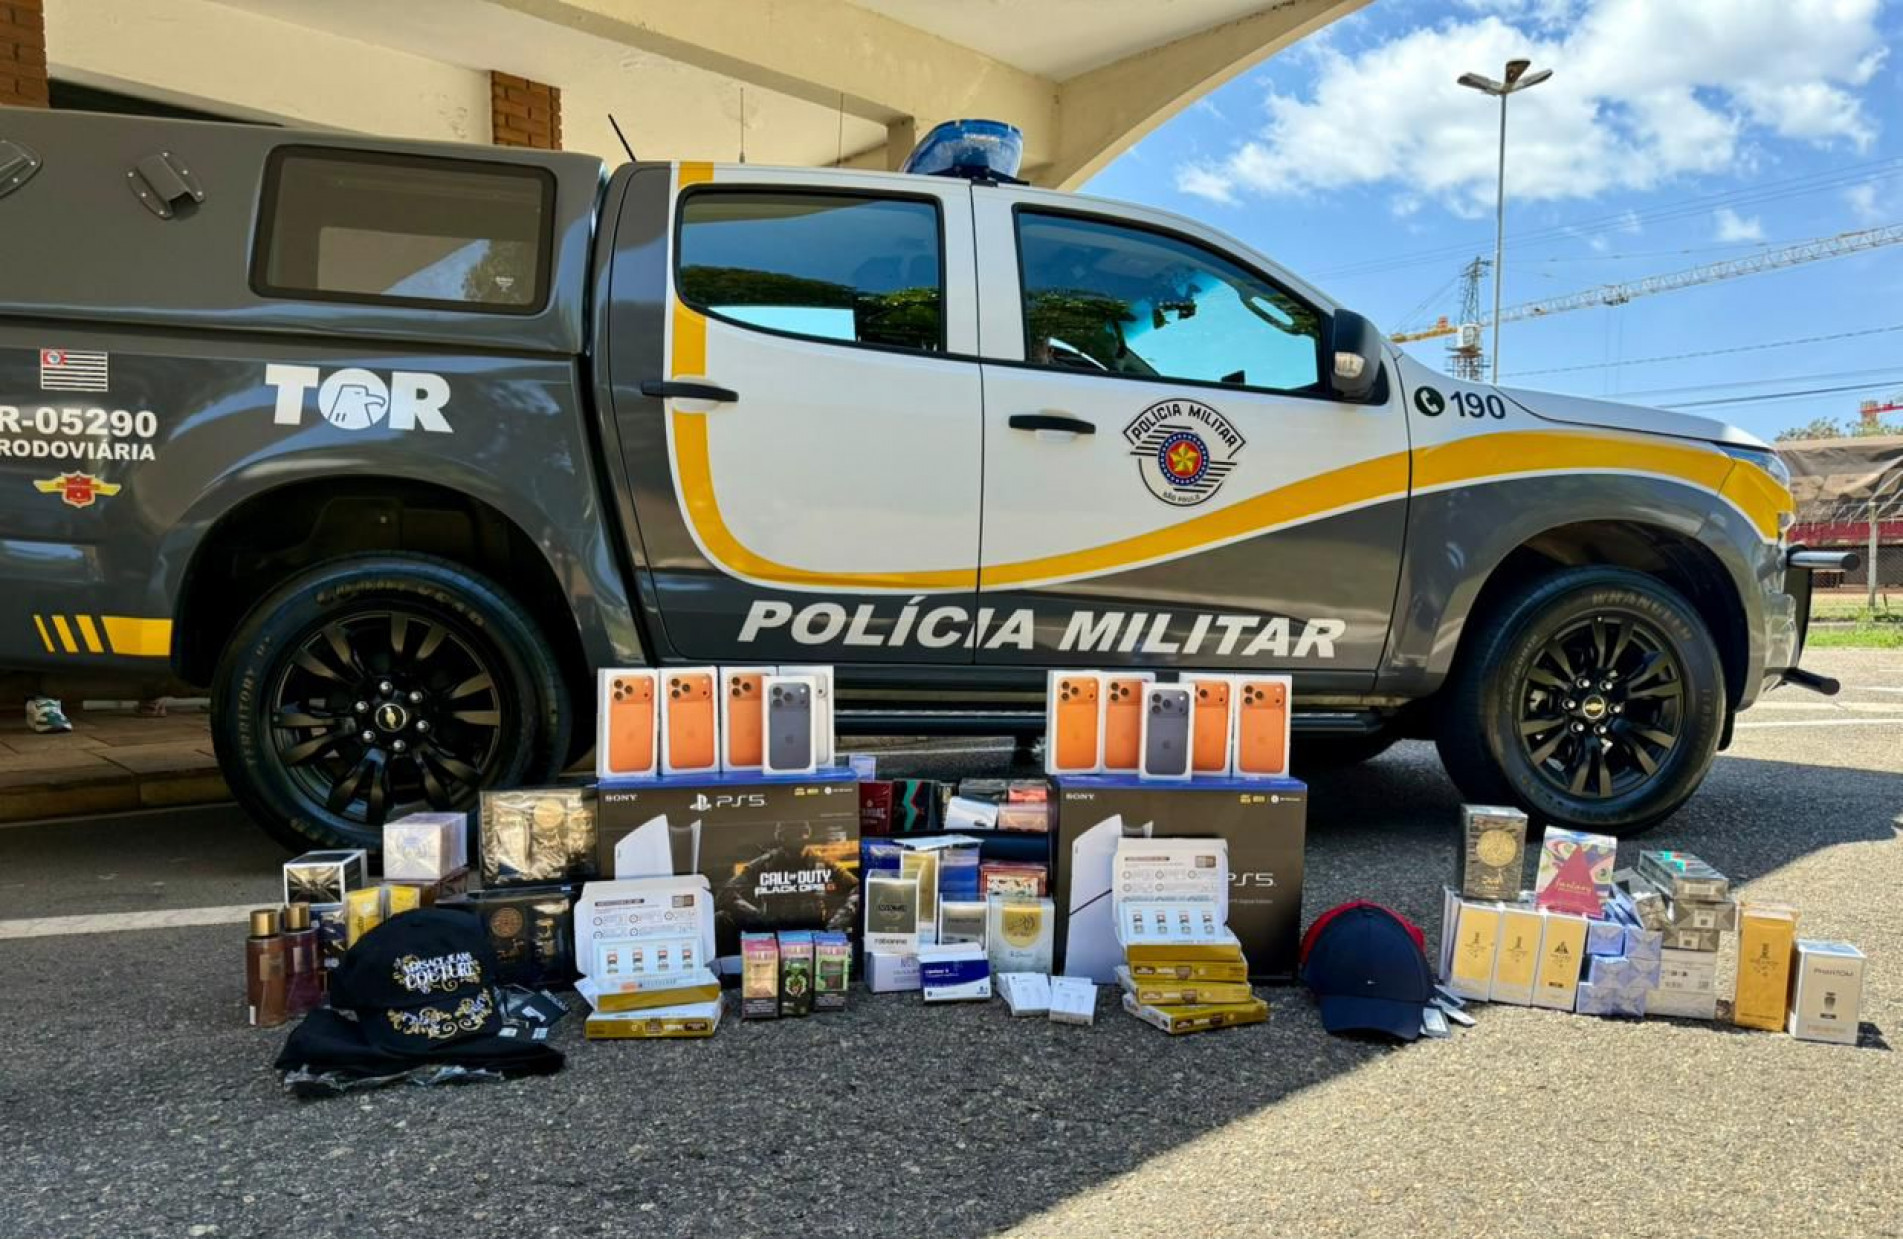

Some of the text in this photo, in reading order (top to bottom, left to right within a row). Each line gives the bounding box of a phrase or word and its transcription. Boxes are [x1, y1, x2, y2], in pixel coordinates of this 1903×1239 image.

[265, 363, 453, 433] TOR
[1450, 390, 1506, 420] 190
[0, 405, 157, 438] R-05290
[1187, 404, 1238, 448] MILITAR
[0, 438, 156, 460] RODOVIÁRIA
[737, 596, 1347, 659] POLÍCIA MILITAR
[605, 794, 638, 803] SONY
[716, 794, 766, 808] PS5
[1065, 792, 1095, 801] SONY
[759, 871, 789, 886] CALL
[797, 869, 832, 884] DUTY
